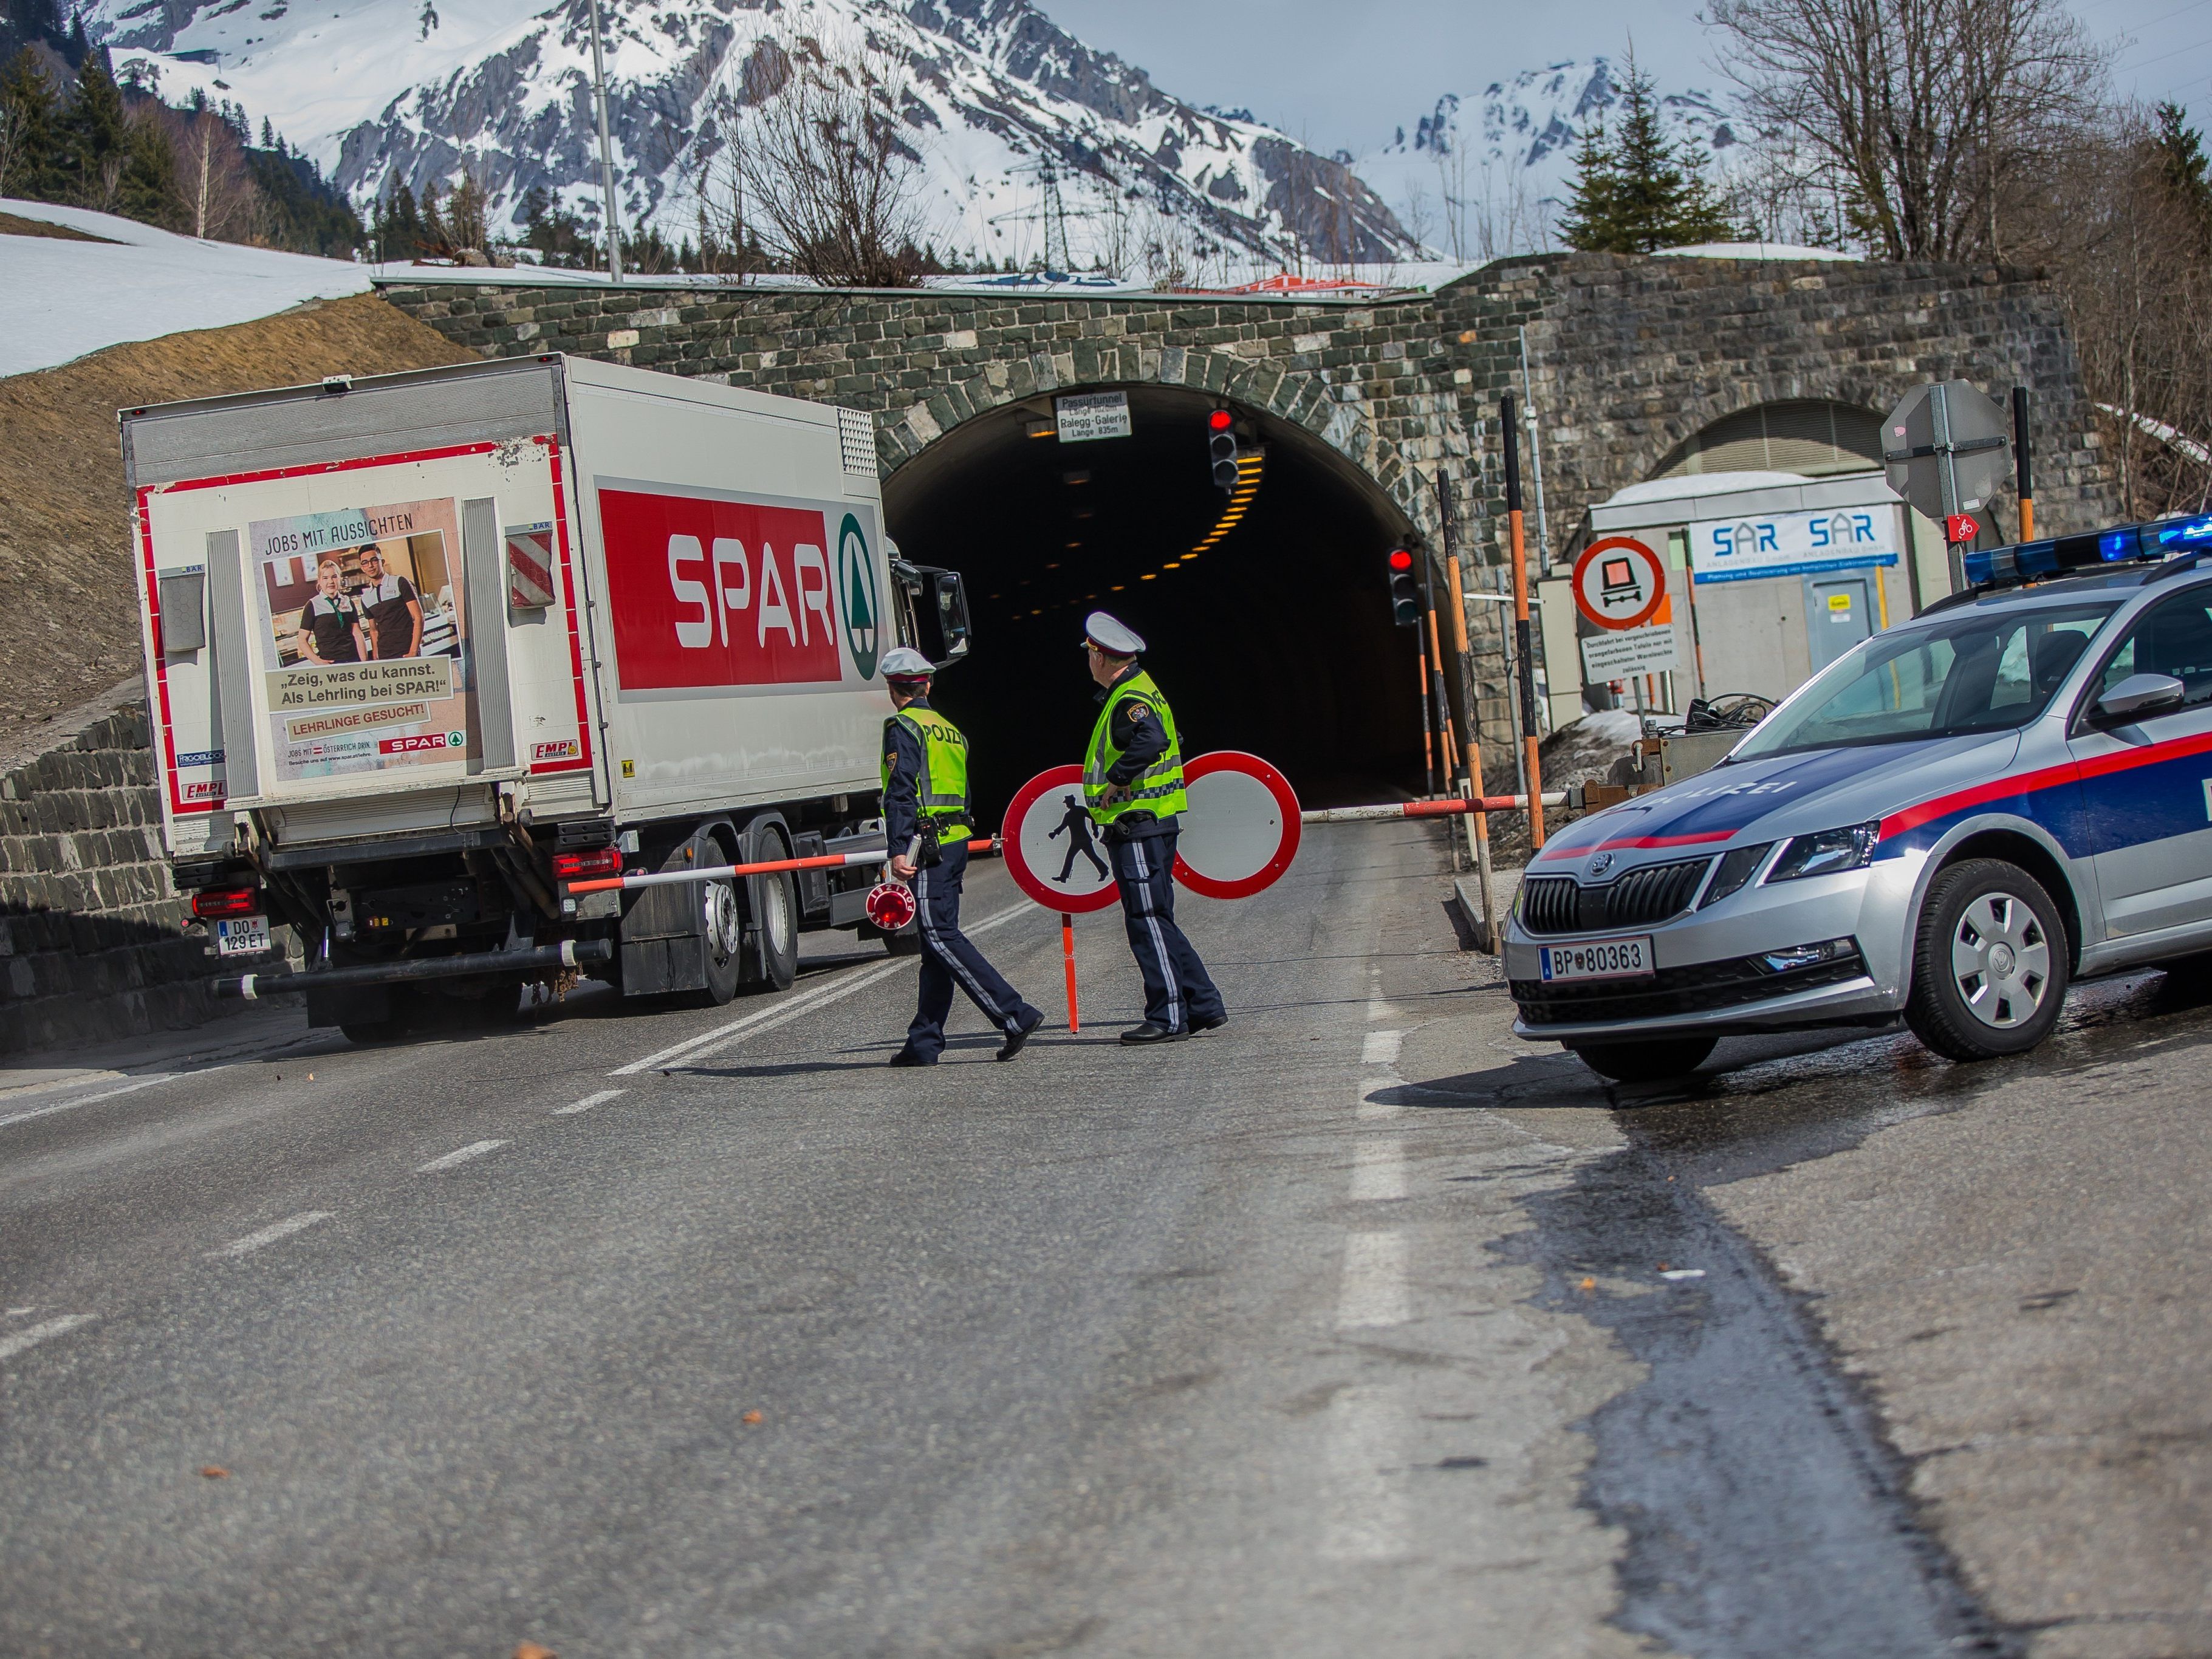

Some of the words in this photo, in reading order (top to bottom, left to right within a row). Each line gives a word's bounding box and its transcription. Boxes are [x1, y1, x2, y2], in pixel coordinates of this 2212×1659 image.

[265, 534, 298, 555] JOBS
[303, 529, 324, 548] MIT
[331, 513, 413, 543] AUSSICHTEN
[1713, 522, 1779, 557] SAR
[1809, 513, 1875, 547] SAR
[668, 534, 833, 648] SPAR
[281, 674, 323, 689] „Zeig,
[326, 671, 355, 683] was
[360, 668, 377, 680] du
[382, 664, 435, 679] kannst.
[281, 692, 304, 705] Als
[309, 687, 365, 702] Lehrling
[371, 684, 392, 697] bei
[396, 680, 446, 695] SPAR!“
[293, 715, 360, 735] LEHRLINGE
[363, 703, 424, 723] GESUCHT!
[323, 743, 356, 753] ÖSTERREICH
[392, 736, 445, 751] SPAR
[187, 782, 224, 798] EMPL
[871, 884, 914, 912] POLIZEI
[233, 920, 250, 934] DO
[225, 936, 246, 950] 129
[249, 932, 264, 948] ET
[1553, 950, 1573, 974] BP
[1585, 943, 1641, 971] 80363
